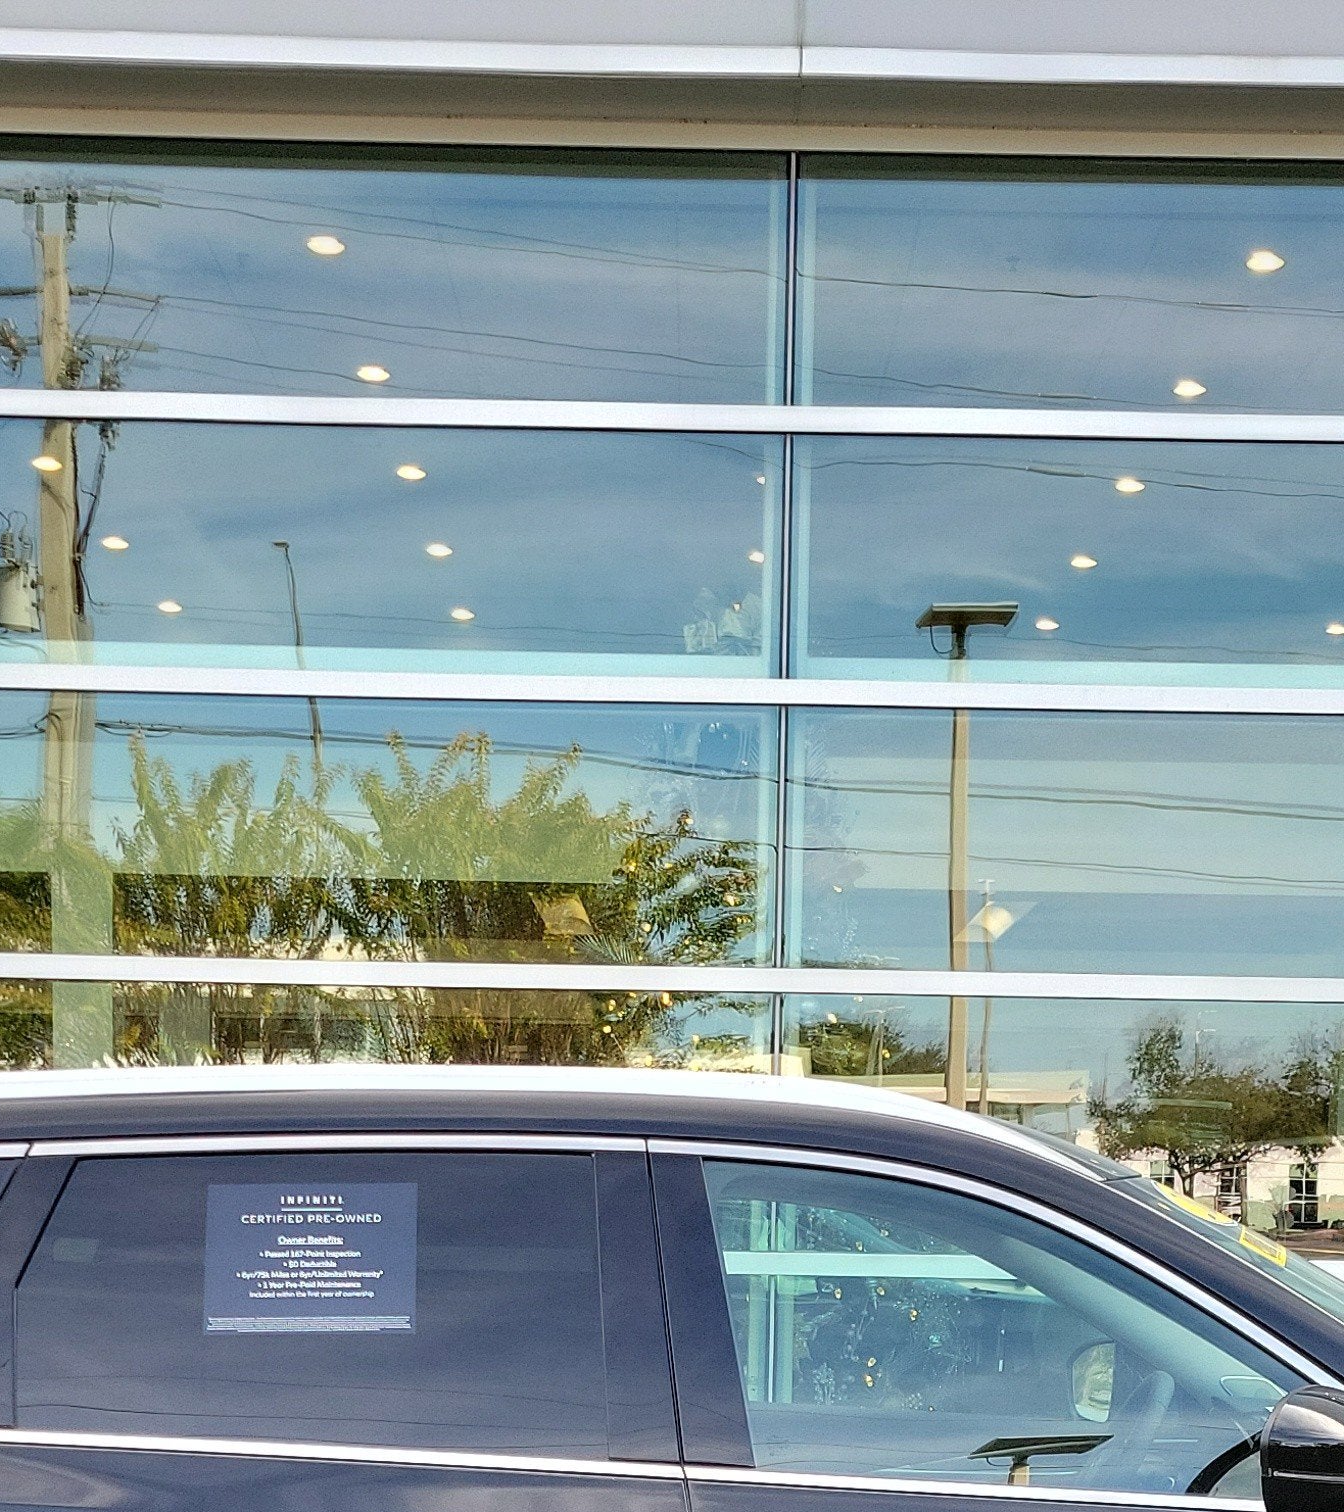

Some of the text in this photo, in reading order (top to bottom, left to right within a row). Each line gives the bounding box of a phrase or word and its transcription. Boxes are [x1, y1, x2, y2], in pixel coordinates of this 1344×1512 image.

[280, 1195, 344, 1205] INFINITI
[241, 1213, 382, 1224] CERTIFIED PRE-OWNED
[277, 1235, 344, 1245] Owner Benefits:
